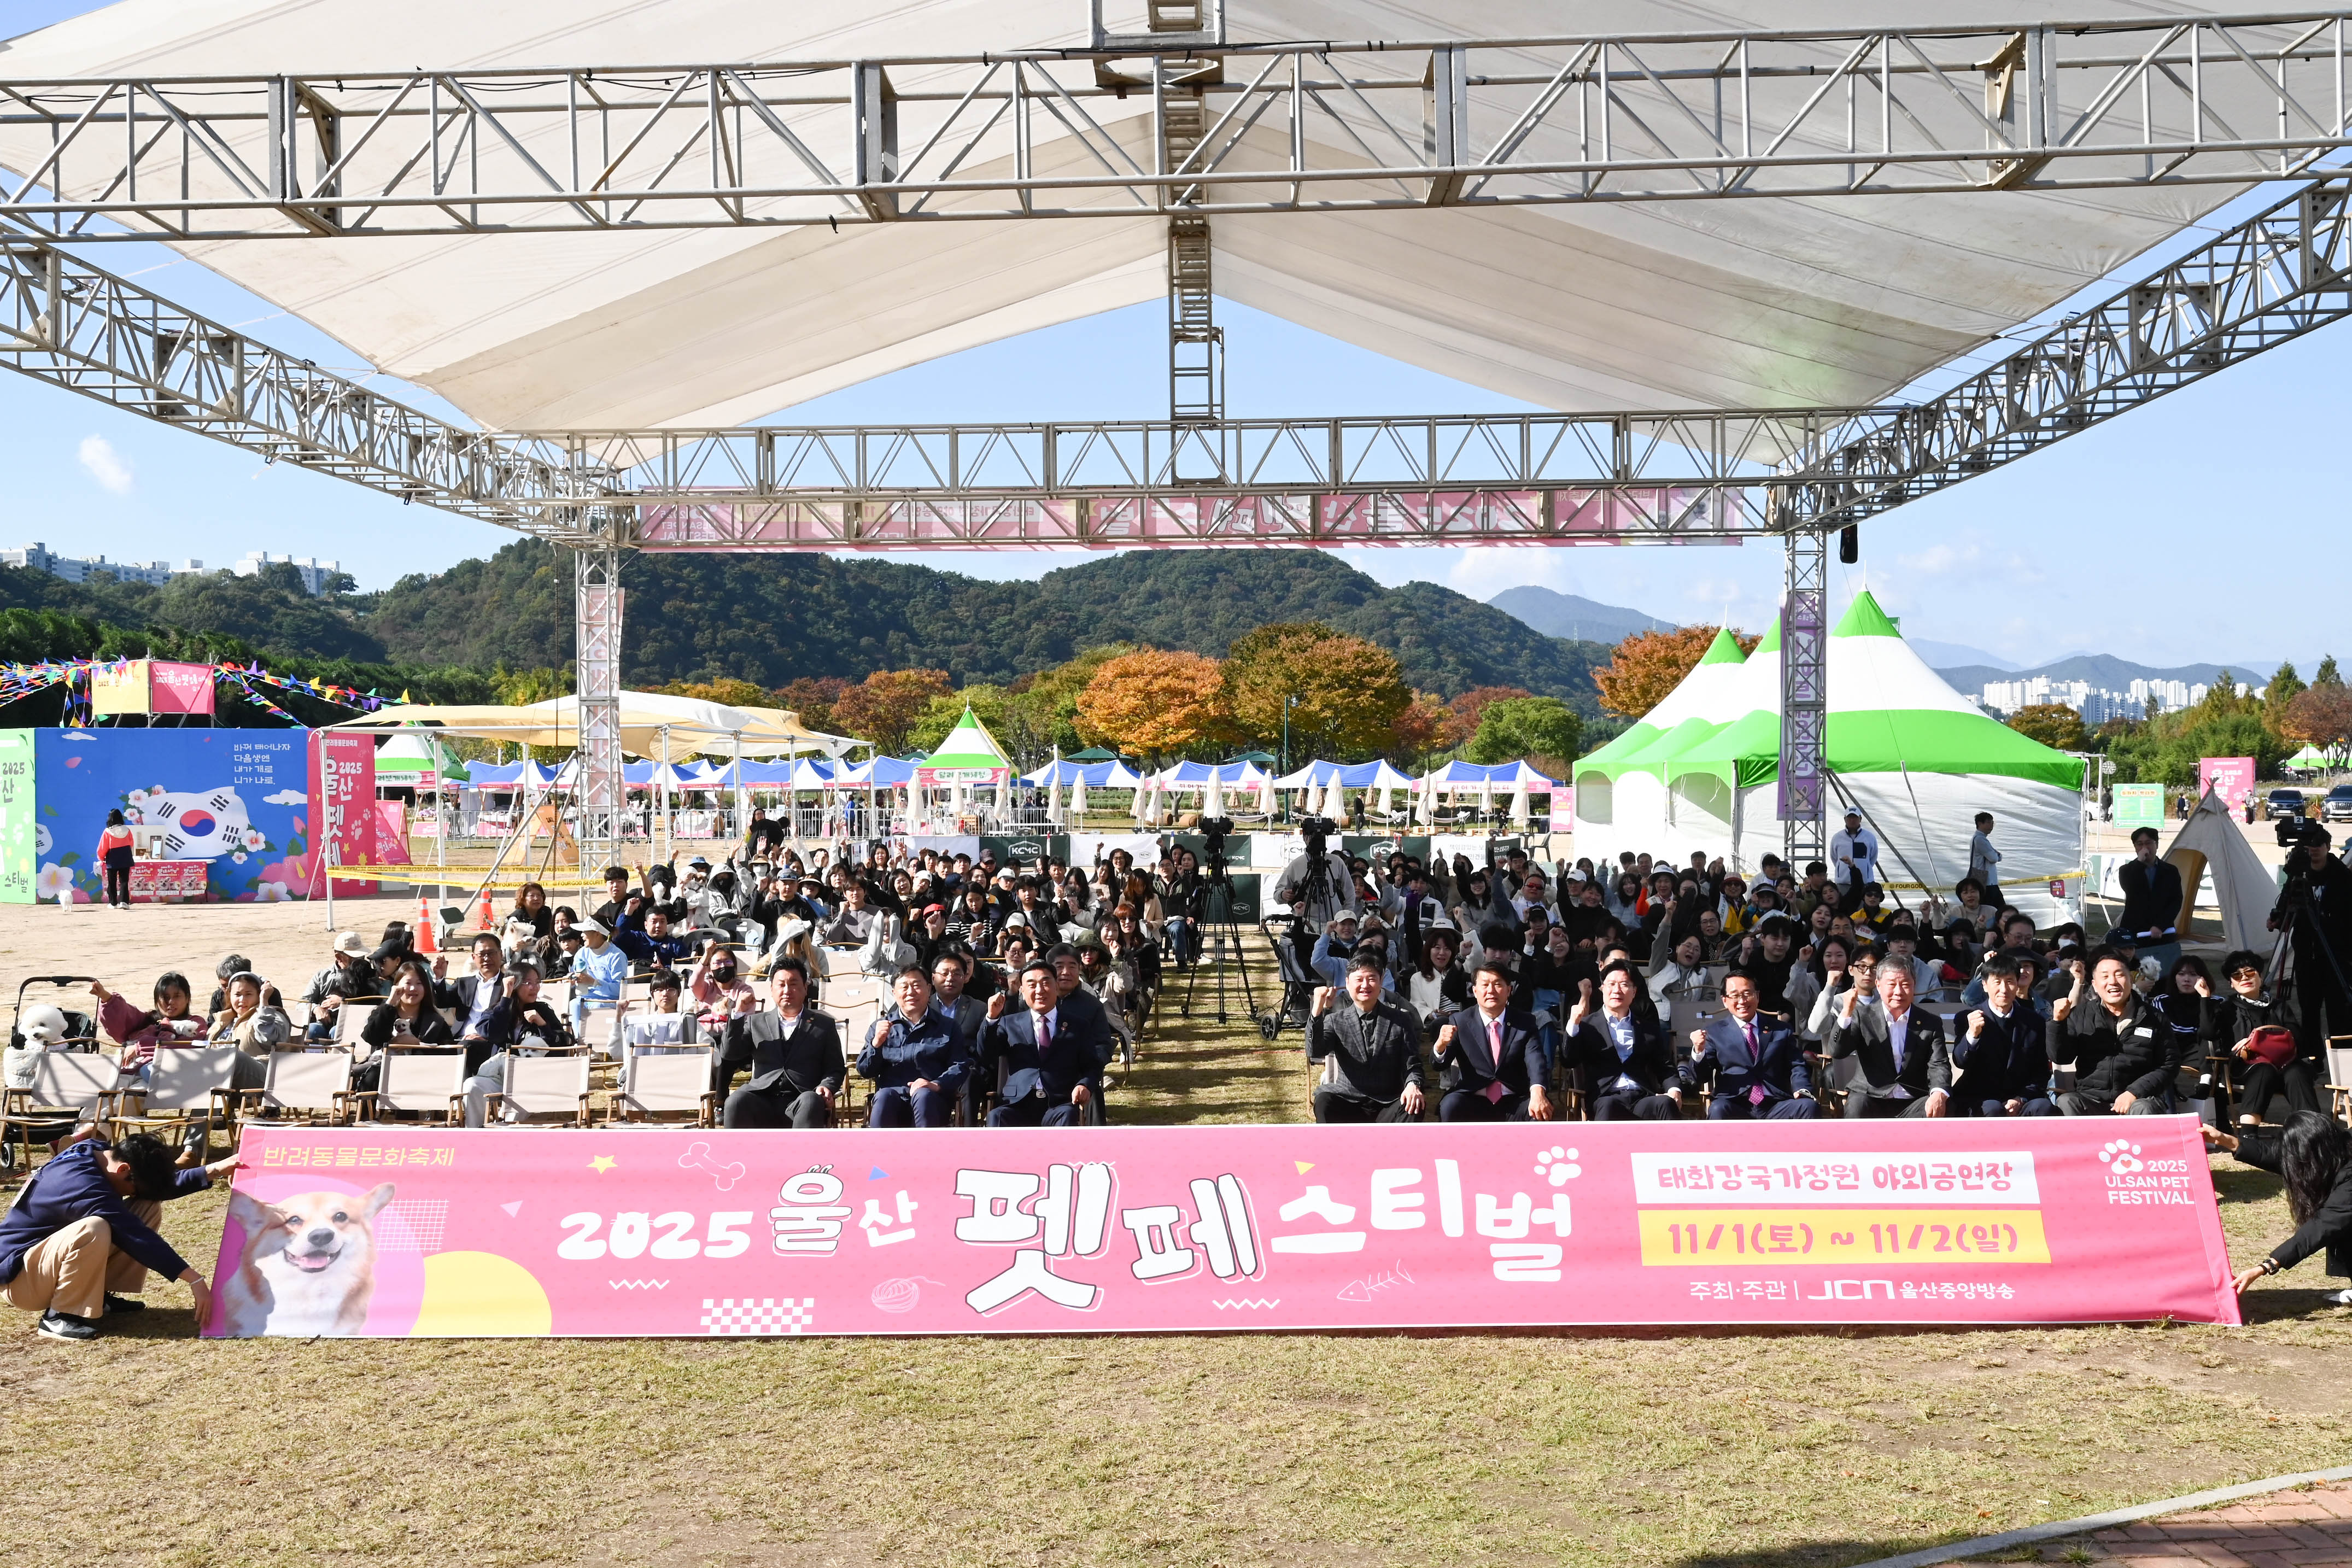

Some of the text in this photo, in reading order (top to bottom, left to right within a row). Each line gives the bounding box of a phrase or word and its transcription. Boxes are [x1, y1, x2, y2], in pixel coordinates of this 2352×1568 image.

[3, 762, 25, 775] 2025
[339, 762, 362, 774] 2025
[263, 1146, 455, 1167] 반려동물문화축제
[2147, 1159, 2187, 1172] 2025
[1657, 1161, 2013, 1192] 태화강국가정원 야외공연장
[2104, 1175, 2190, 1188] ULSAN PET
[2108, 1190, 2195, 1205] FESTIVAL
[557, 1159, 1572, 1315] 2025 울산 펫페스티벌
[1668, 1222, 1815, 1255] 11/1(토)
[1869, 1222, 2018, 1254] 11/2(일)
[1689, 1280, 1787, 1301] 주최·주관
[1898, 1281, 2016, 1300] 울산중앙방송
